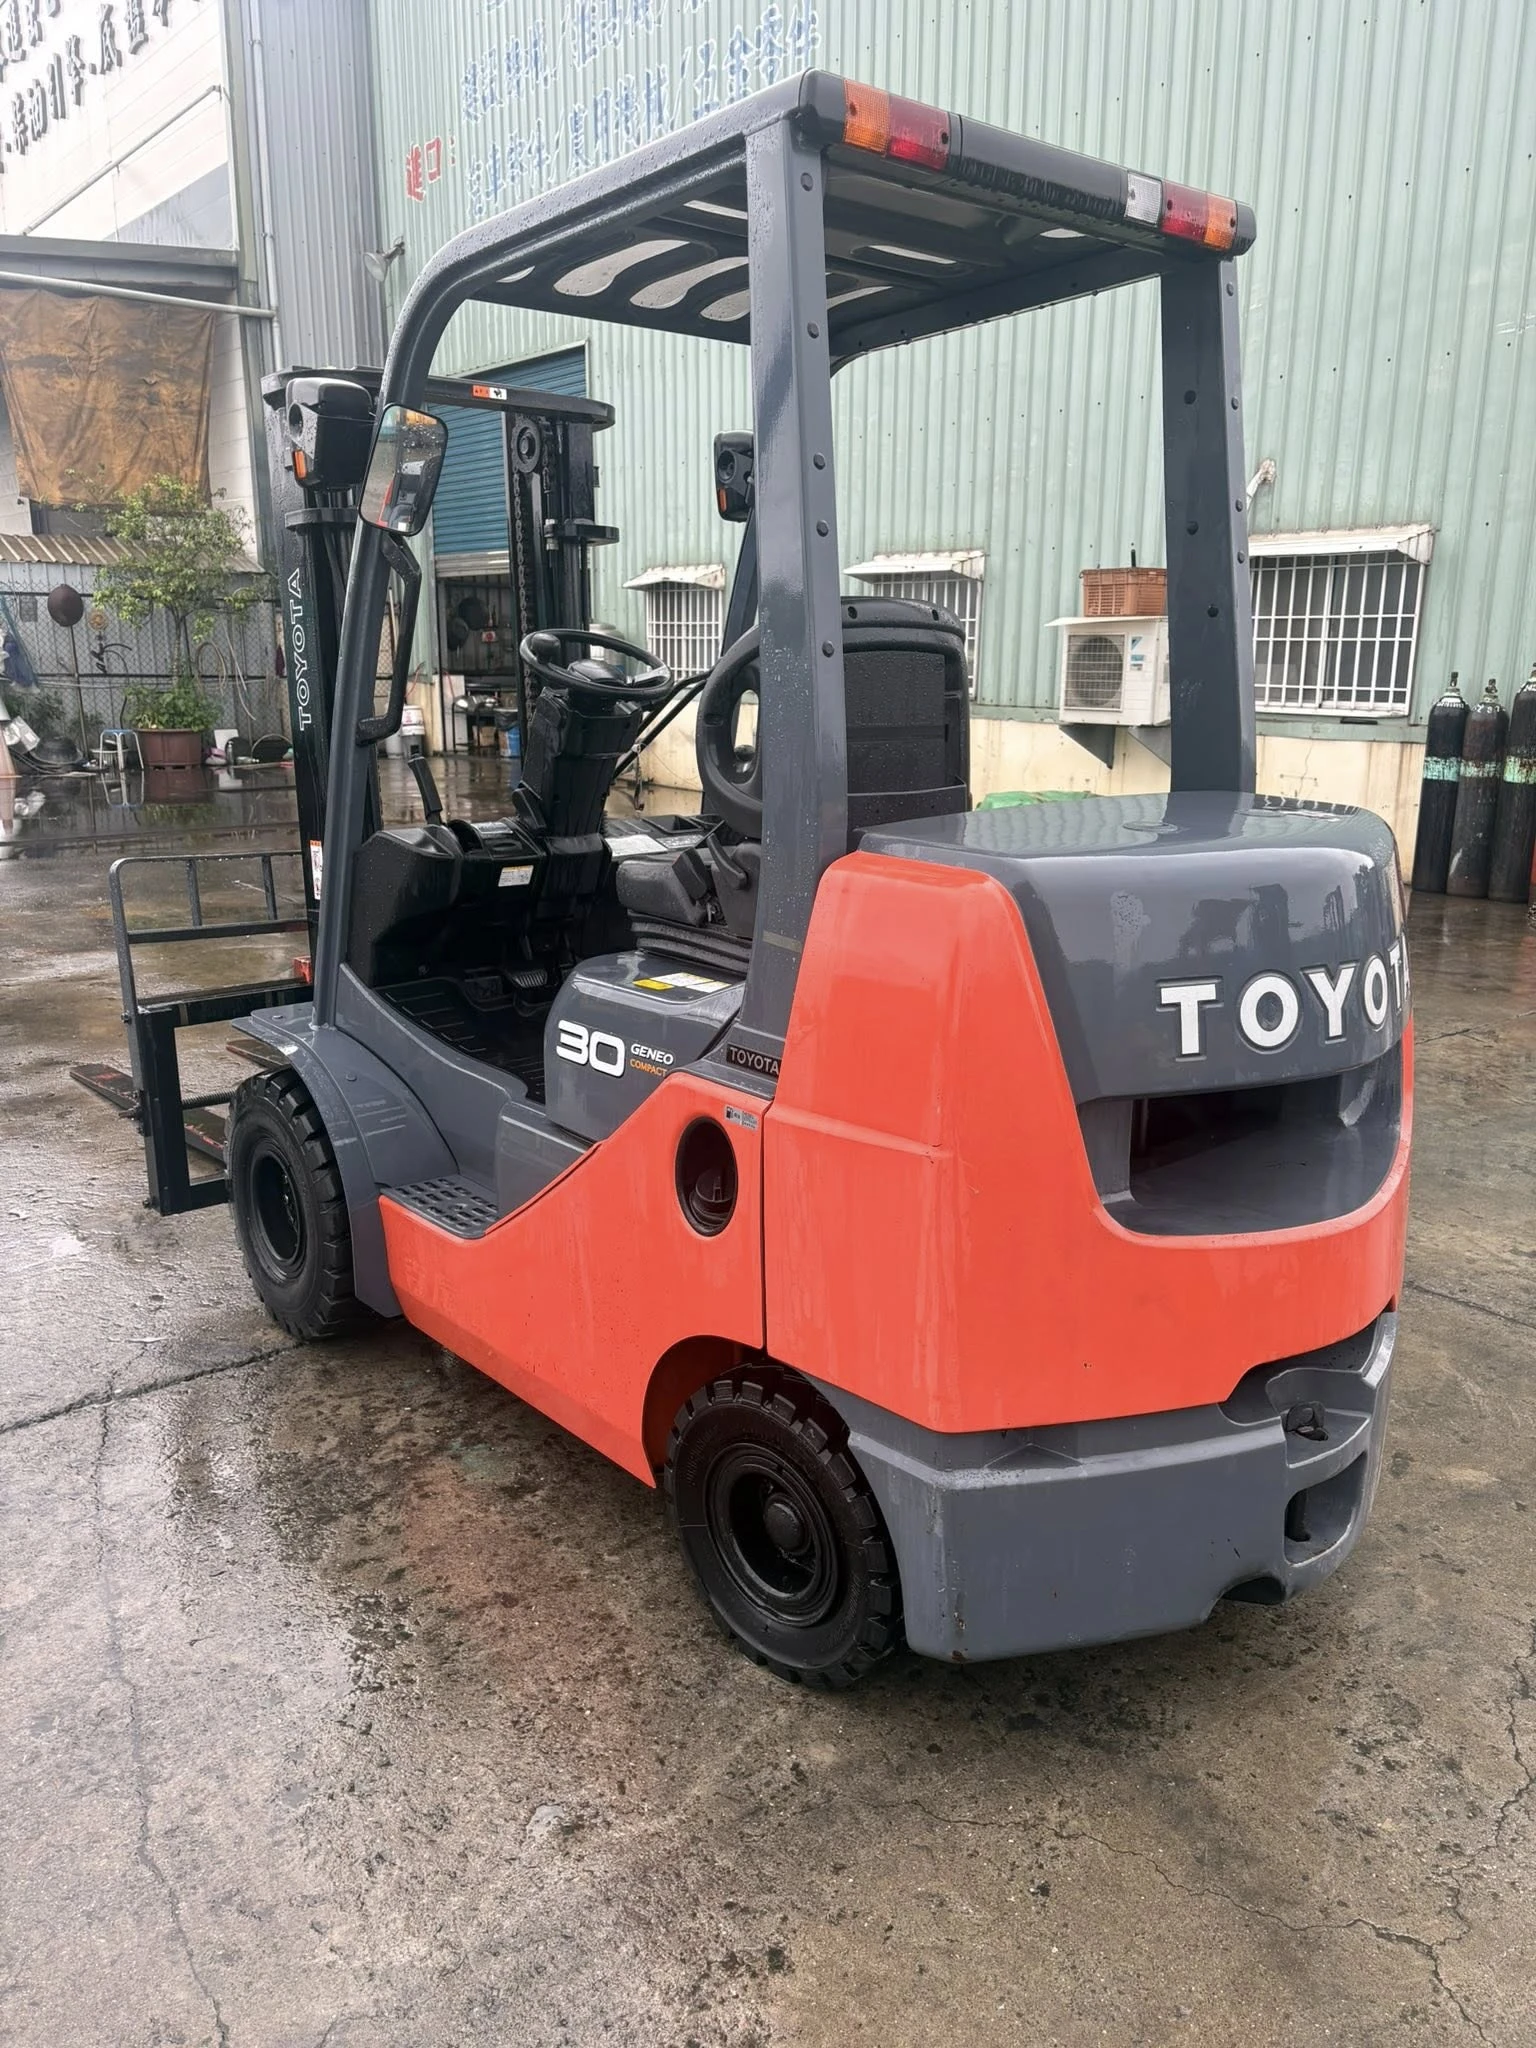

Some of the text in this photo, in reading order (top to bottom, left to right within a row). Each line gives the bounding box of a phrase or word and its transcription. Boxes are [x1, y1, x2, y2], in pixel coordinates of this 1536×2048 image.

[288, 567, 312, 732] TOYOTA
[556, 1020, 626, 1078] 30
[630, 1043, 674, 1065] GENEO
[730, 1046, 780, 1075] TOYOTA
[629, 1058, 667, 1077] COMPACT
